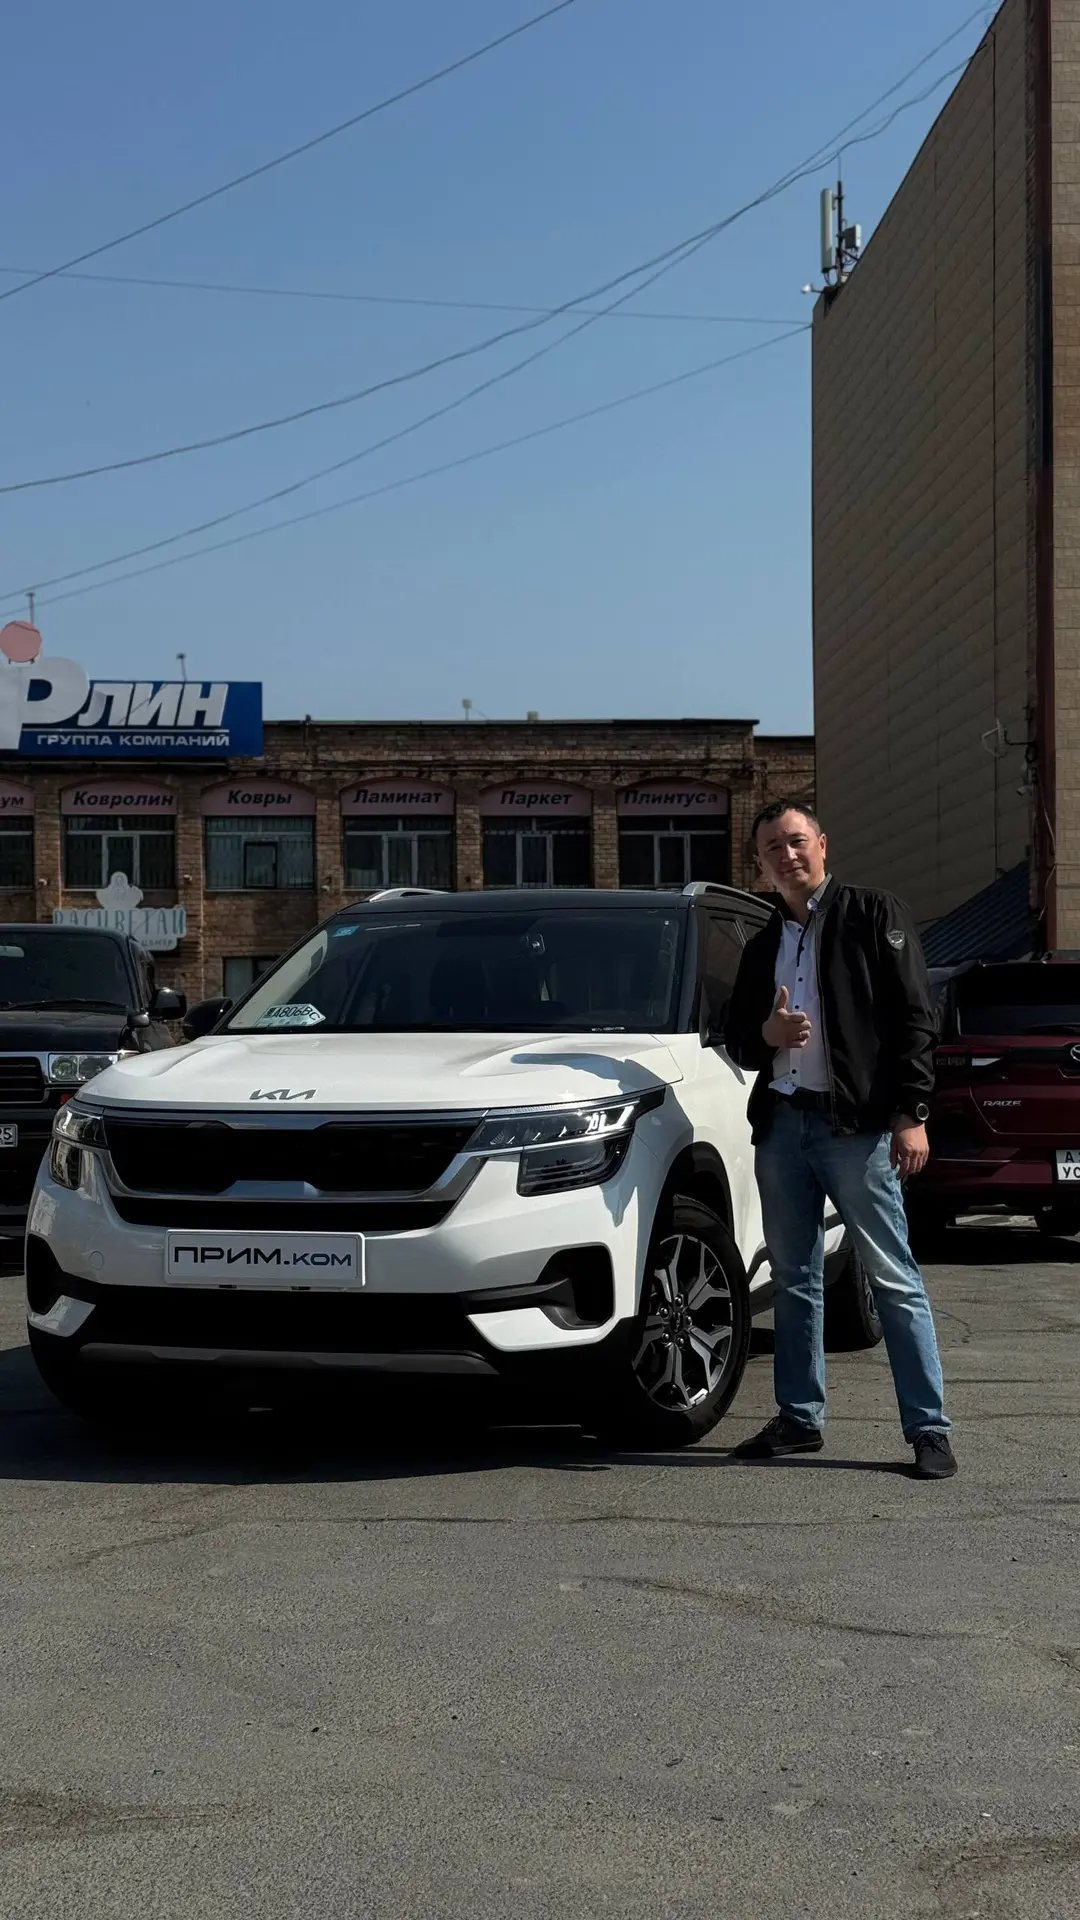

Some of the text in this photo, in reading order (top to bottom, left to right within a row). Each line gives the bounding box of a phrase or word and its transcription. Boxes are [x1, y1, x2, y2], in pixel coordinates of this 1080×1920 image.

[36, 733, 230, 747] ГРУППА КОМПАНИЙ
[73, 790, 174, 809] Ковролин
[227, 789, 292, 808] Ковры
[352, 789, 443, 805] Ламинат
[500, 790, 573, 809] Паркет
[624, 790, 718, 808] Плинтуса
[1065, 1150, 1080, 1163] А
